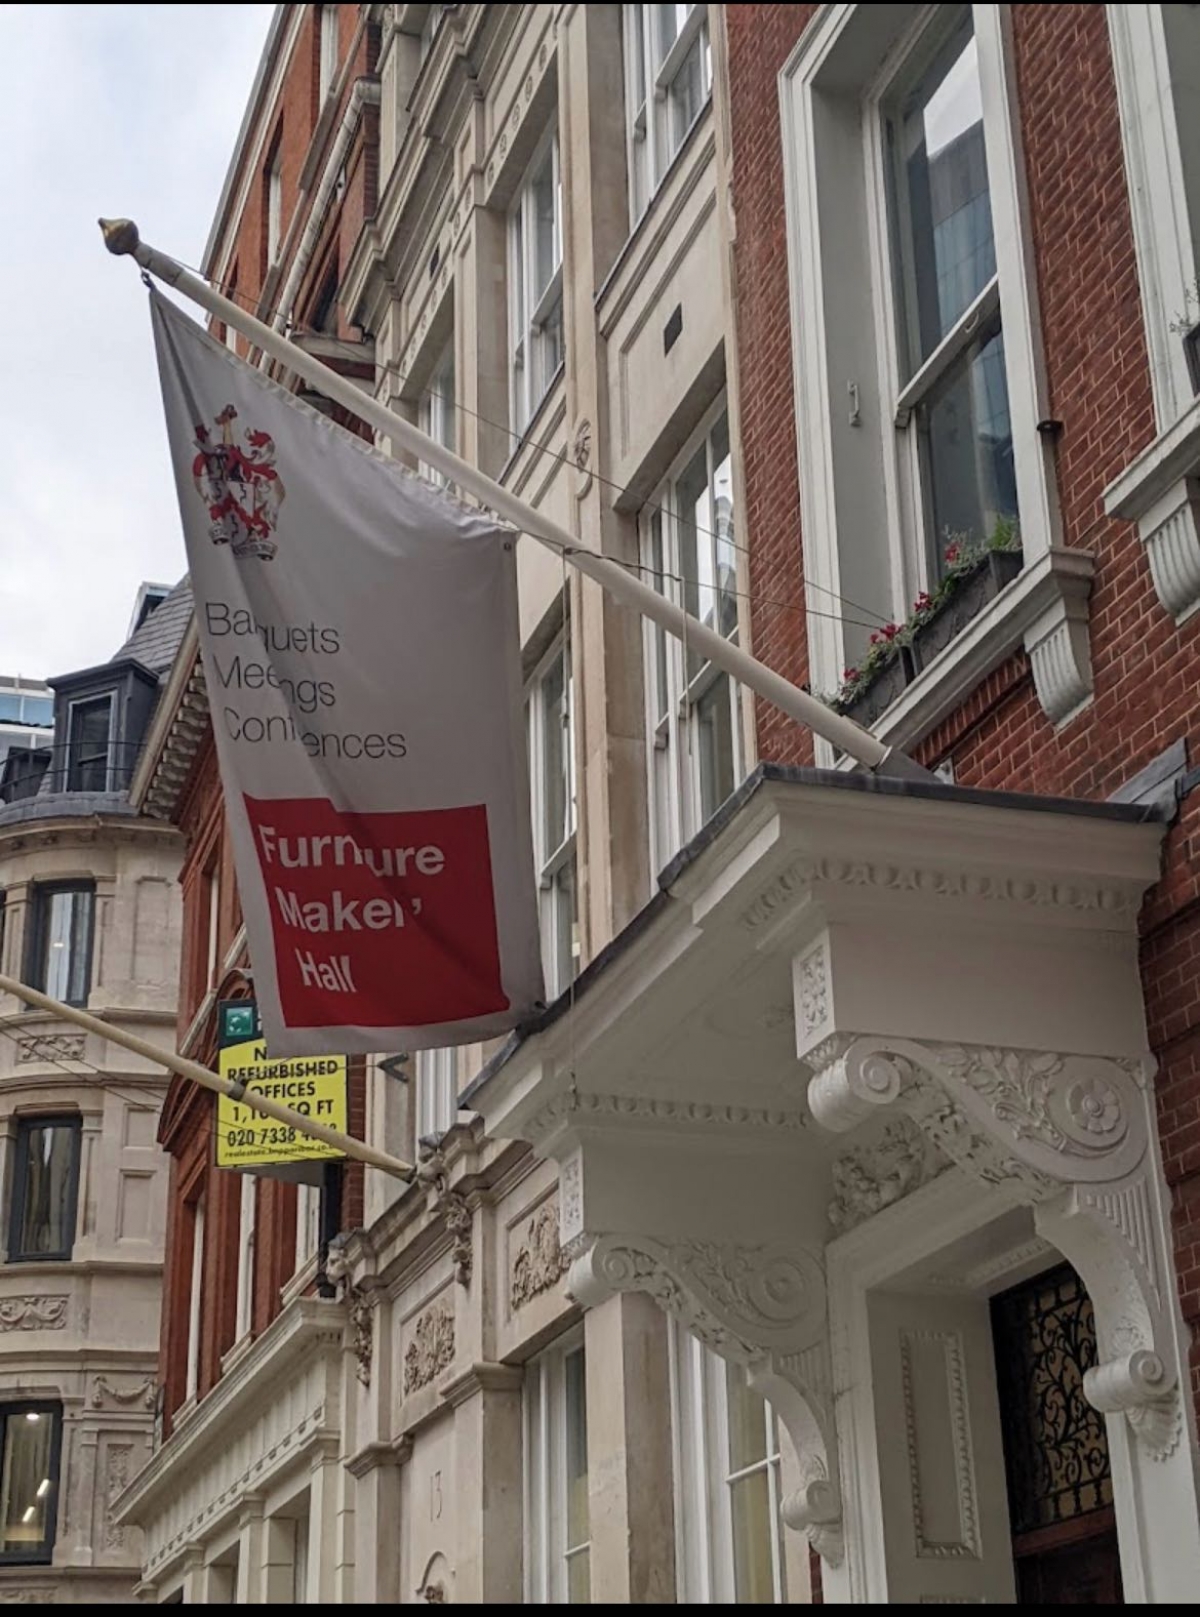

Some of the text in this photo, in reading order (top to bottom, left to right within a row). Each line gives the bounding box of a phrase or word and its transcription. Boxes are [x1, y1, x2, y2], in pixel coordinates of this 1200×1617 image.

[206, 602, 340, 653] Bauets
[212, 654, 336, 713] Meengs
[224, 706, 407, 758] Conences
[258, 824, 445, 876] Furnure
[295, 948, 357, 992] Hall
[227, 1060, 338, 1081] REFURBISHED
[317, 1099, 334, 1115] FT
[227, 1129, 255, 1147] 020
[260, 1127, 296, 1144] 7338
